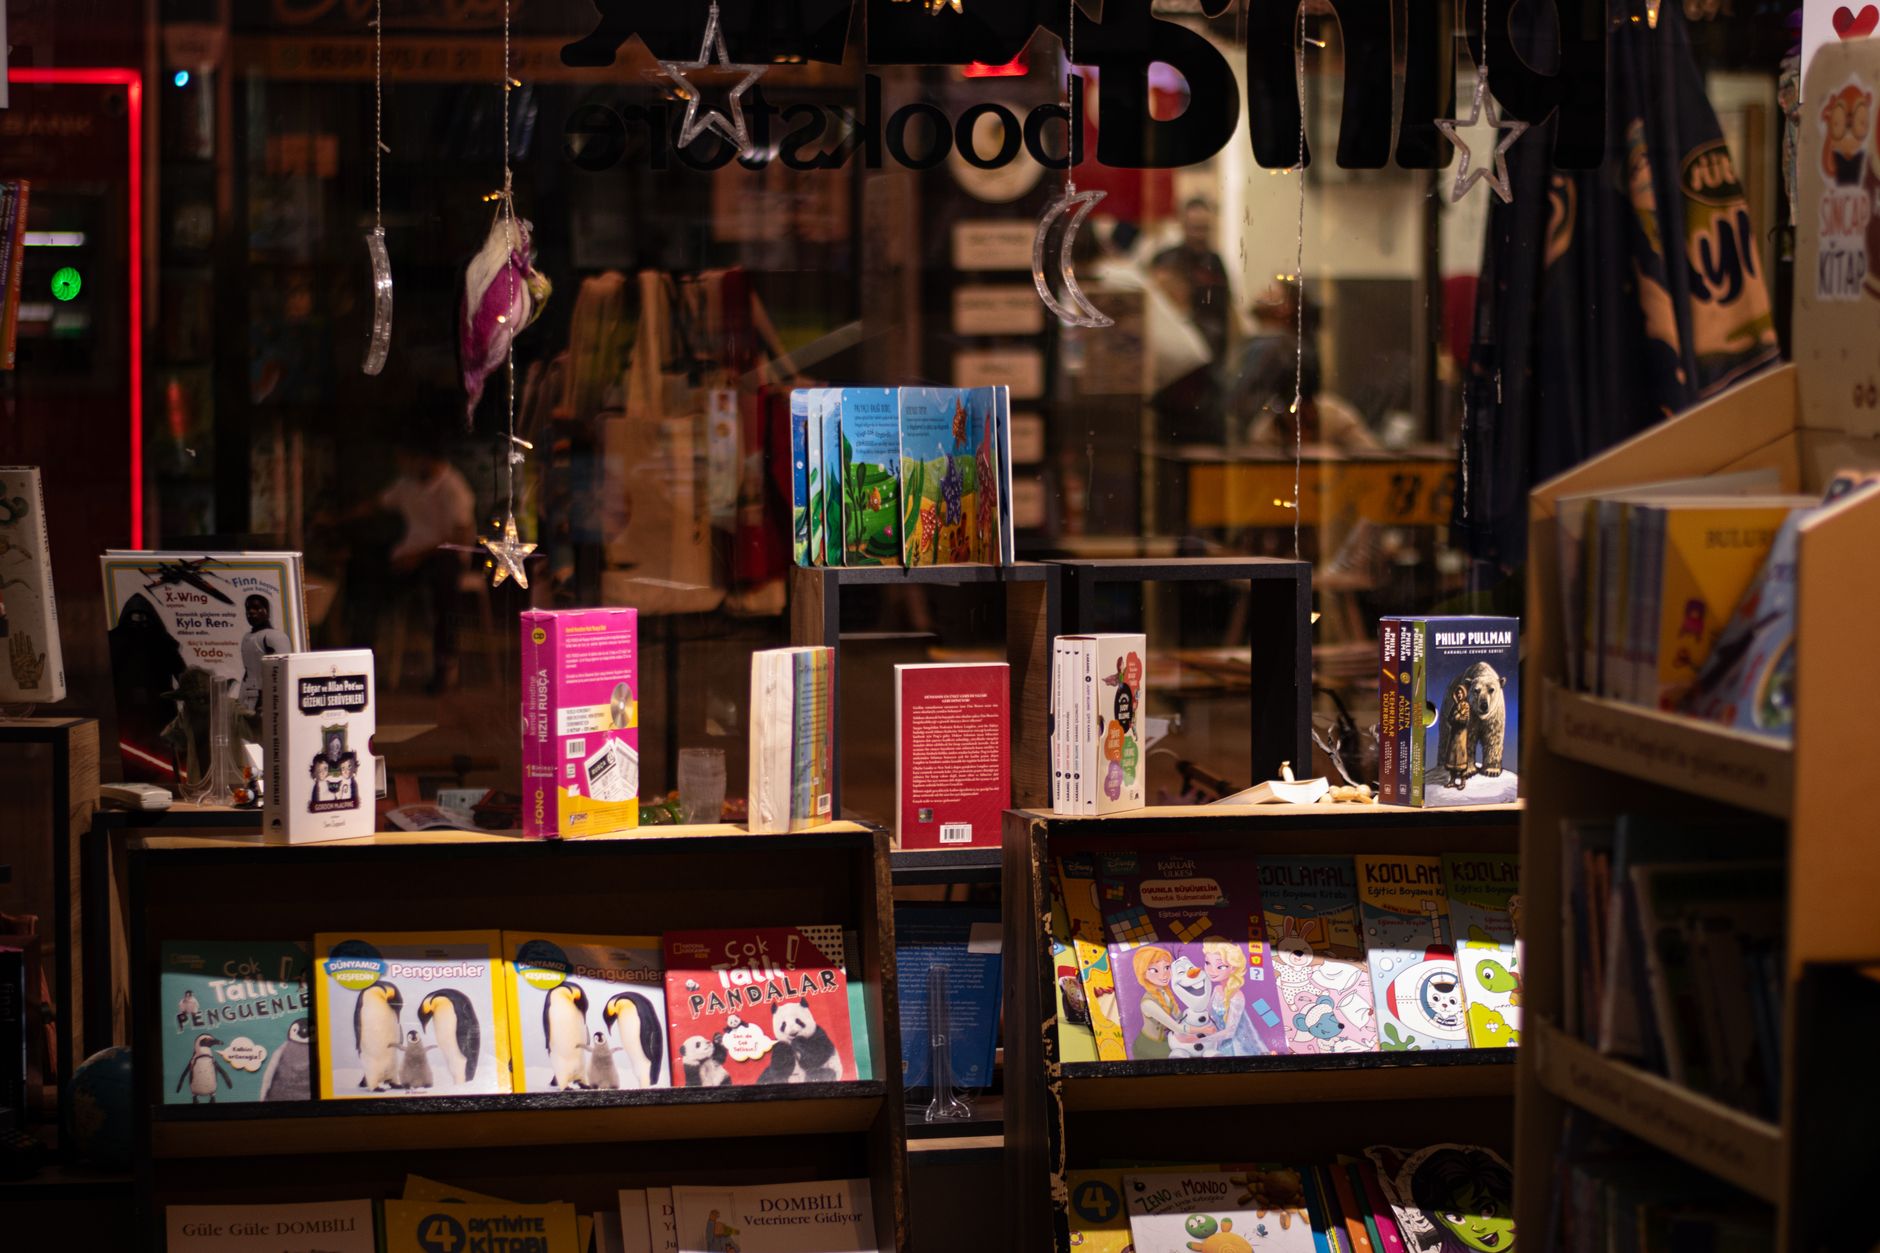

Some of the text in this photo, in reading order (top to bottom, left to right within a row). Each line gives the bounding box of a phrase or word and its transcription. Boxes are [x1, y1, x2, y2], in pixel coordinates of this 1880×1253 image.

[231, 577, 257, 589] Finn
[166, 593, 208, 604] X-Wing
[176, 618, 201, 629] Kylo
[1435, 631, 1512, 646] PHILIP PULLMAN
[528, 676, 537, 736] kendi kendine
[538, 669, 550, 742] HIZLI RUSÇA
[1382, 693, 1390, 735] DÜRBÜN
[1388, 690, 1396, 738] KEHRİBAR
[1141, 887, 1172, 895] OYUNLA
[1368, 886, 1396, 899] Eğitici
[1399, 887, 1434, 898] Boyama
[724, 934, 769, 966] Çok
[223, 956, 263, 983] Çok
[329, 960, 380, 972] DÜNYAMIZI
[391, 963, 485, 981] Penguenler
[519, 960, 567, 972] DÜNYAMIZI
[576, 965, 664, 983] Penguenler
[710, 955, 785, 989] Tatlı
[336, 971, 374, 982] KEŞFEDİN
[208, 973, 278, 1004] Tatlı
[689, 970, 838, 1018] PANDALAR
[760, 1192, 843, 1212] DOMBİLİ
[1081, 1186, 1112, 1217] 4
[1134, 1188, 1172, 1213] ZENO
[1181, 1178, 1228, 1197] MONDO
[182, 1217, 356, 1237] Güle Güle DOMBİLİ
[468, 1215, 546, 1233] AKTİVİTE
[743, 1211, 863, 1226] Veterinere Gidiyor
[425, 1220, 458, 1253] 4
